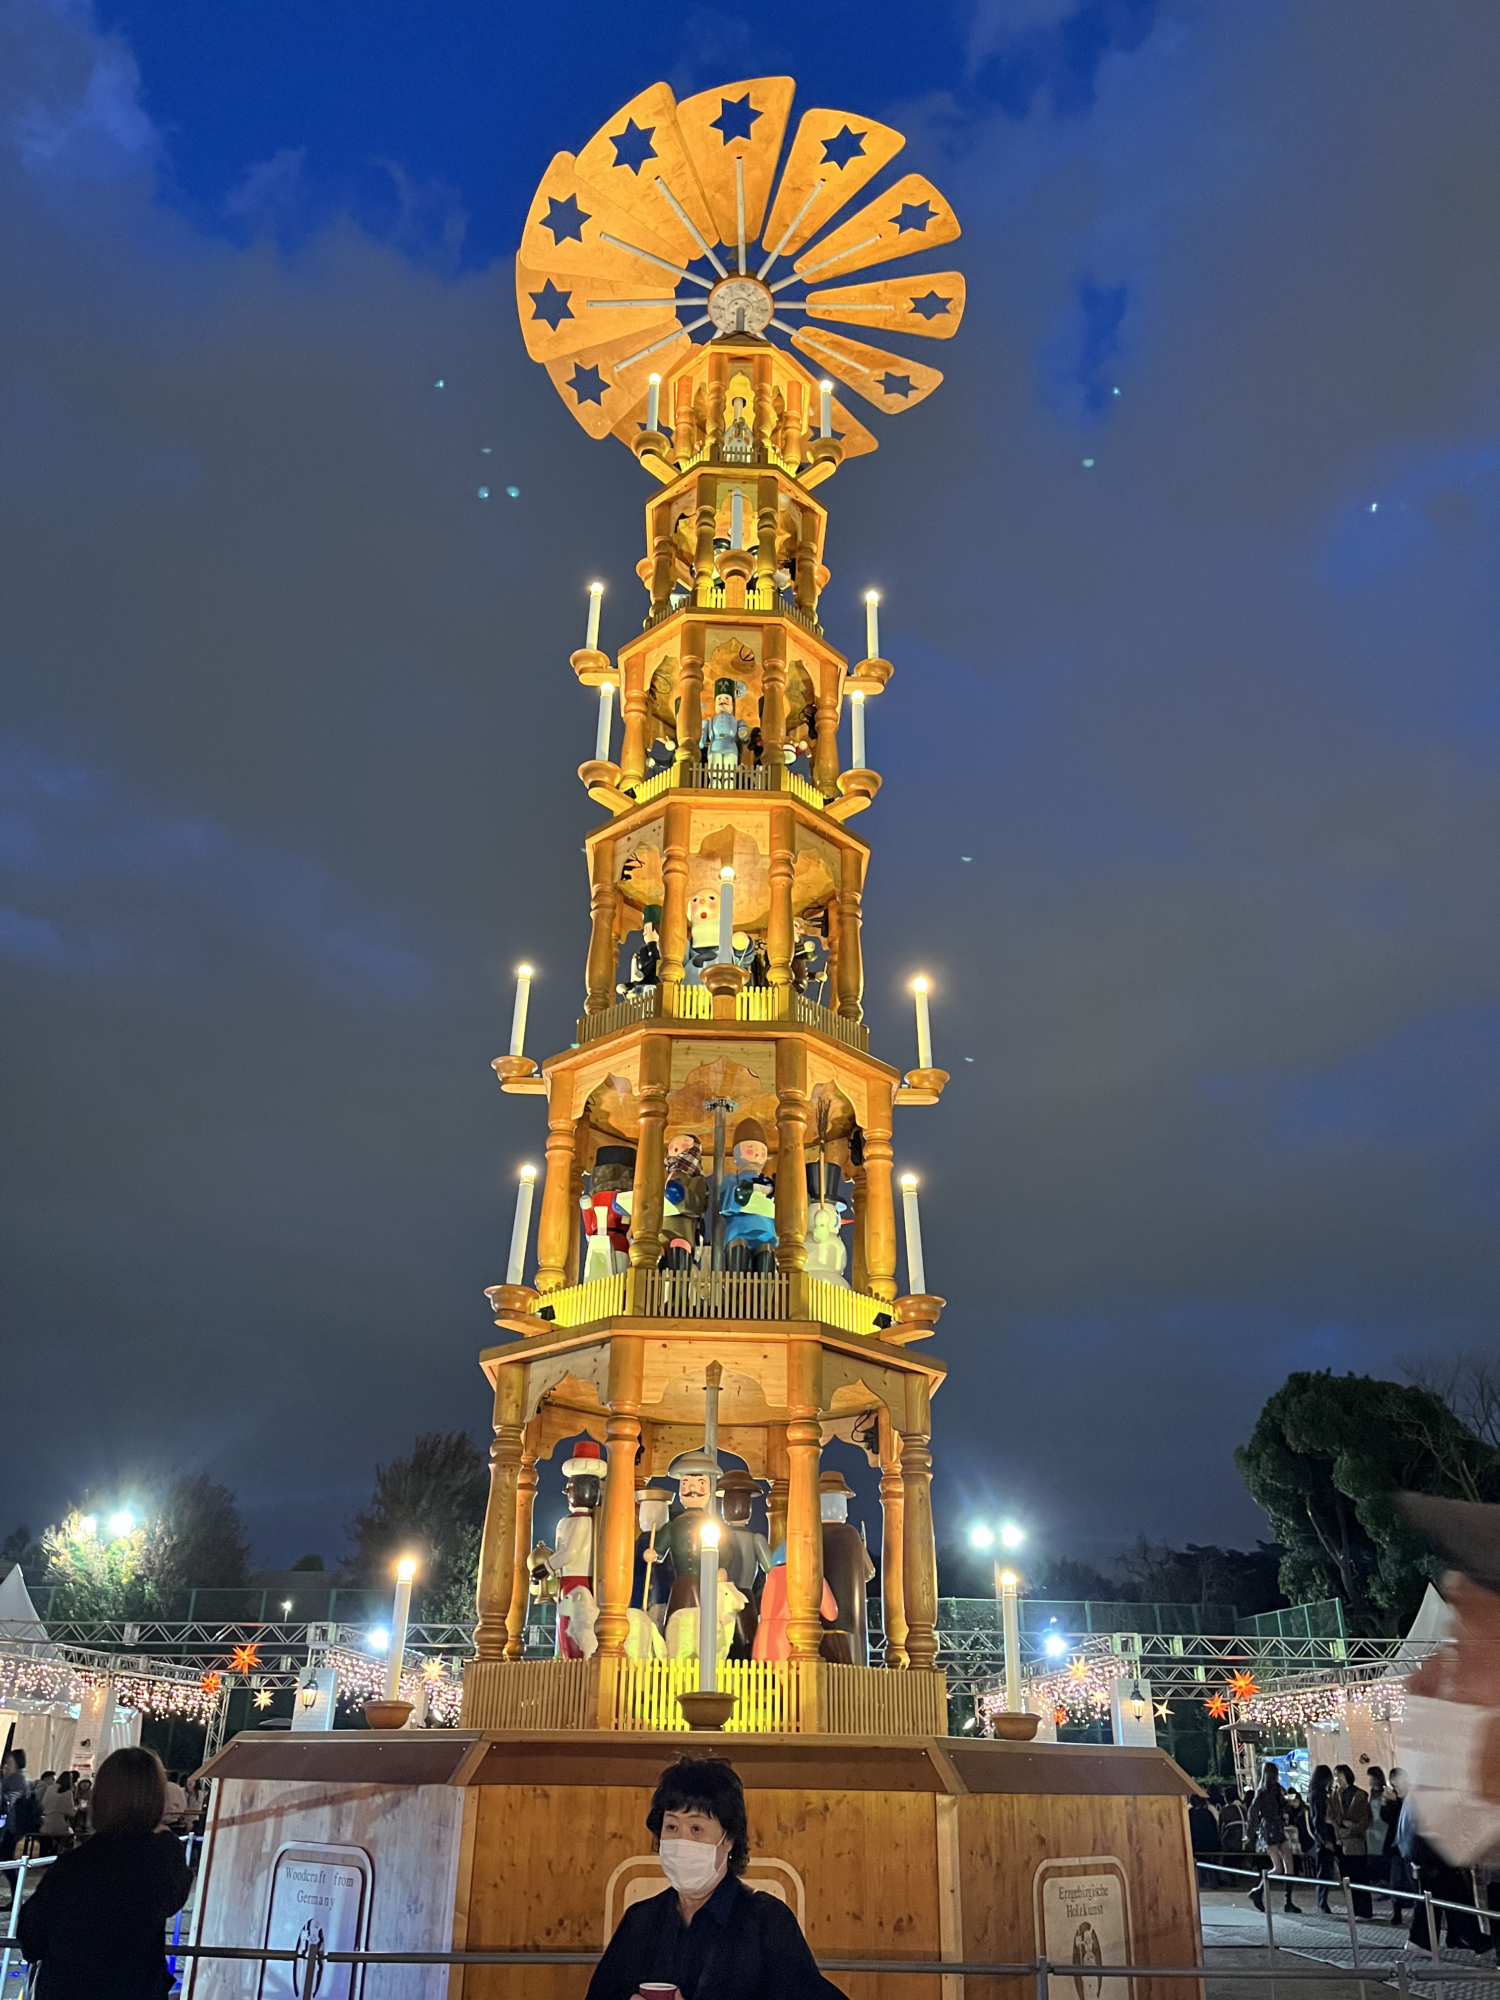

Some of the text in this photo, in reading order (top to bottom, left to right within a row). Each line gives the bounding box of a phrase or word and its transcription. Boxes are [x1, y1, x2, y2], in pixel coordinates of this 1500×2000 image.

[286, 1867, 354, 1888] Woodcraft from
[296, 1890, 335, 1911] Germany
[1058, 1884, 1109, 1902] Erzgebirgische
[1066, 1903, 1103, 1918] Holzkunst
